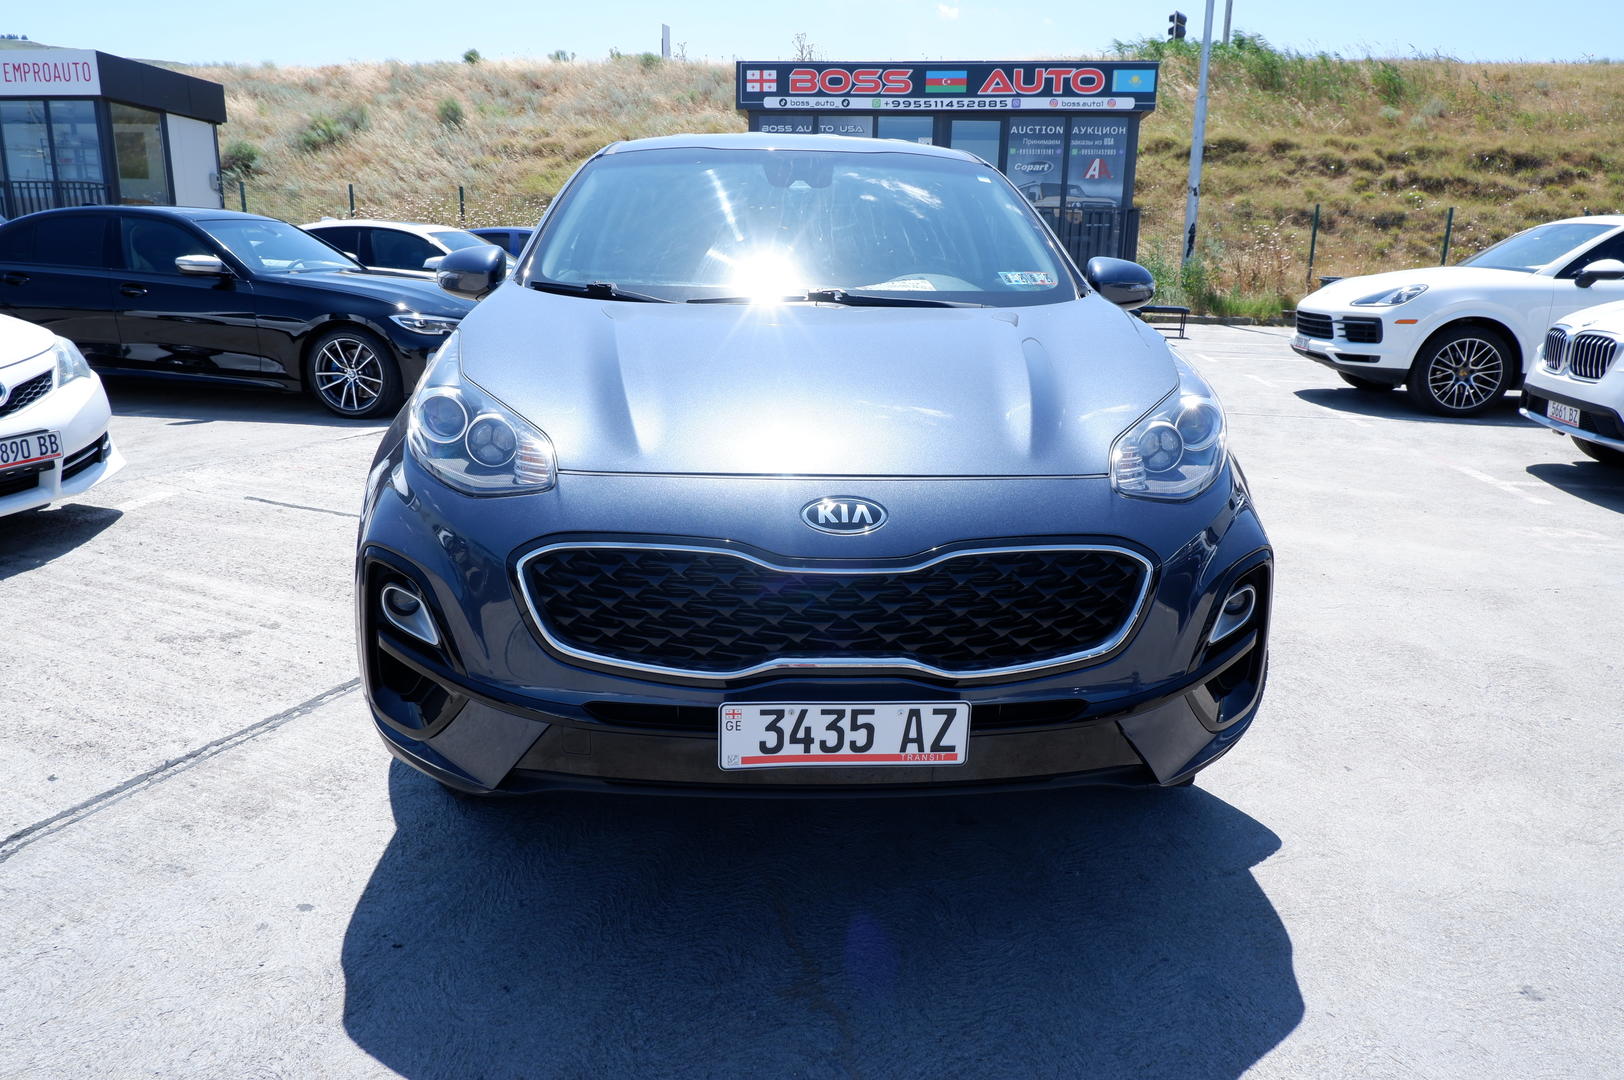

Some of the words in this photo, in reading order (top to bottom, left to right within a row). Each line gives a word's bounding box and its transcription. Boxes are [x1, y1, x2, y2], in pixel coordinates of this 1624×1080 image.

[3, 62, 91, 82] EMPROAUTO
[789, 68, 913, 95] BOSS
[977, 68, 1106, 95] AUTO
[884, 99, 1008, 109] +995511452885
[761, 125, 793, 133] BOSS
[840, 125, 864, 133] USA
[1010, 125, 1064, 134] AUCTION
[1072, 126, 1126, 135] АУКЦИОН
[1014, 162, 1050, 172] Copart
[0, 439, 31, 463] 890
[37, 434, 59, 456] BB
[817, 501, 873, 524] KIA
[725, 720, 742, 731] GE
[758, 708, 876, 754] 3435
[899, 708, 958, 753] AZ
[901, 753, 946, 761] TRANSIT
